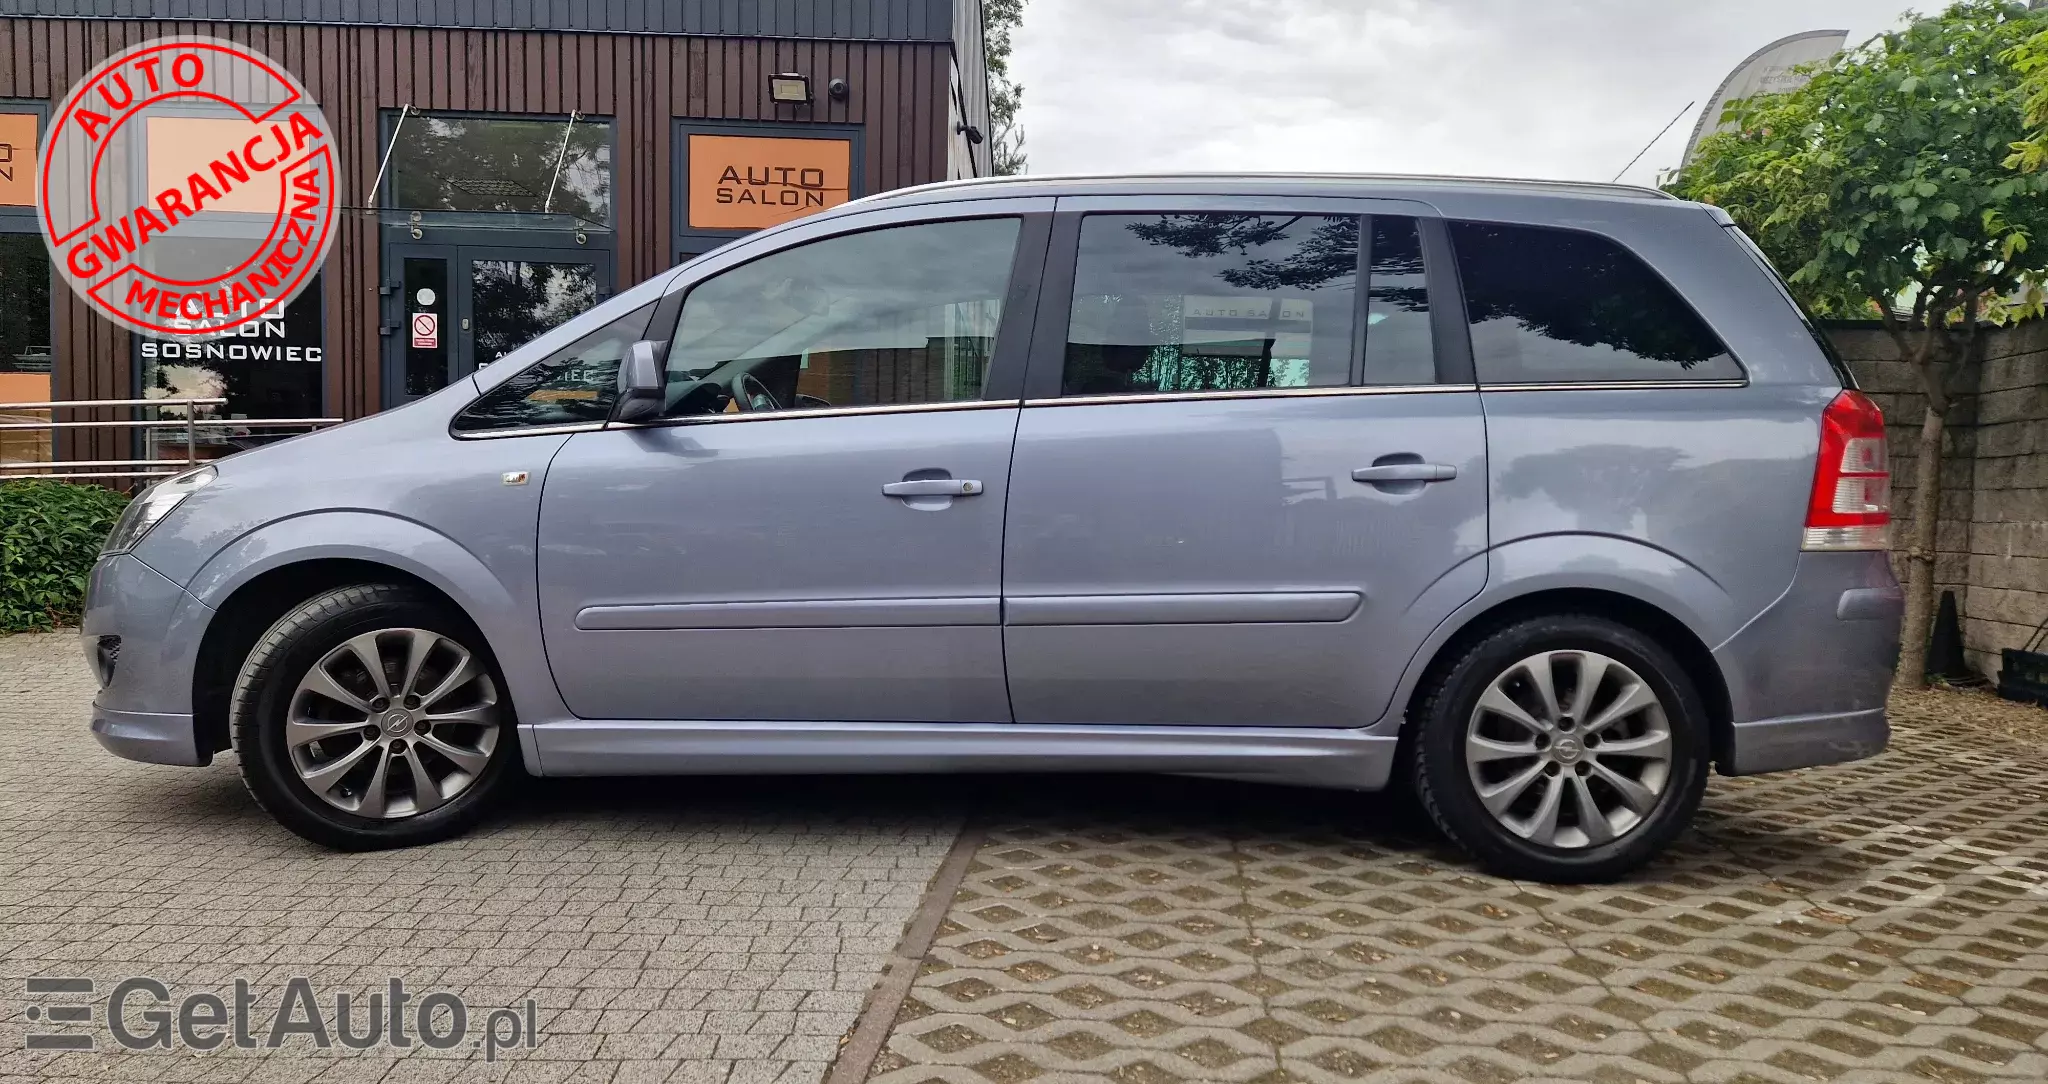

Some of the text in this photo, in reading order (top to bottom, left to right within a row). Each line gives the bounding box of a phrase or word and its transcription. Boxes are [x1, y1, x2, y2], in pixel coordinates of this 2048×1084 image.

[717, 165, 824, 188] AUTO
[716, 187, 824, 207] SALON
[1193, 308, 1305, 318] AUTO SAON
[141, 342, 322, 362] SOSNOWIEC
